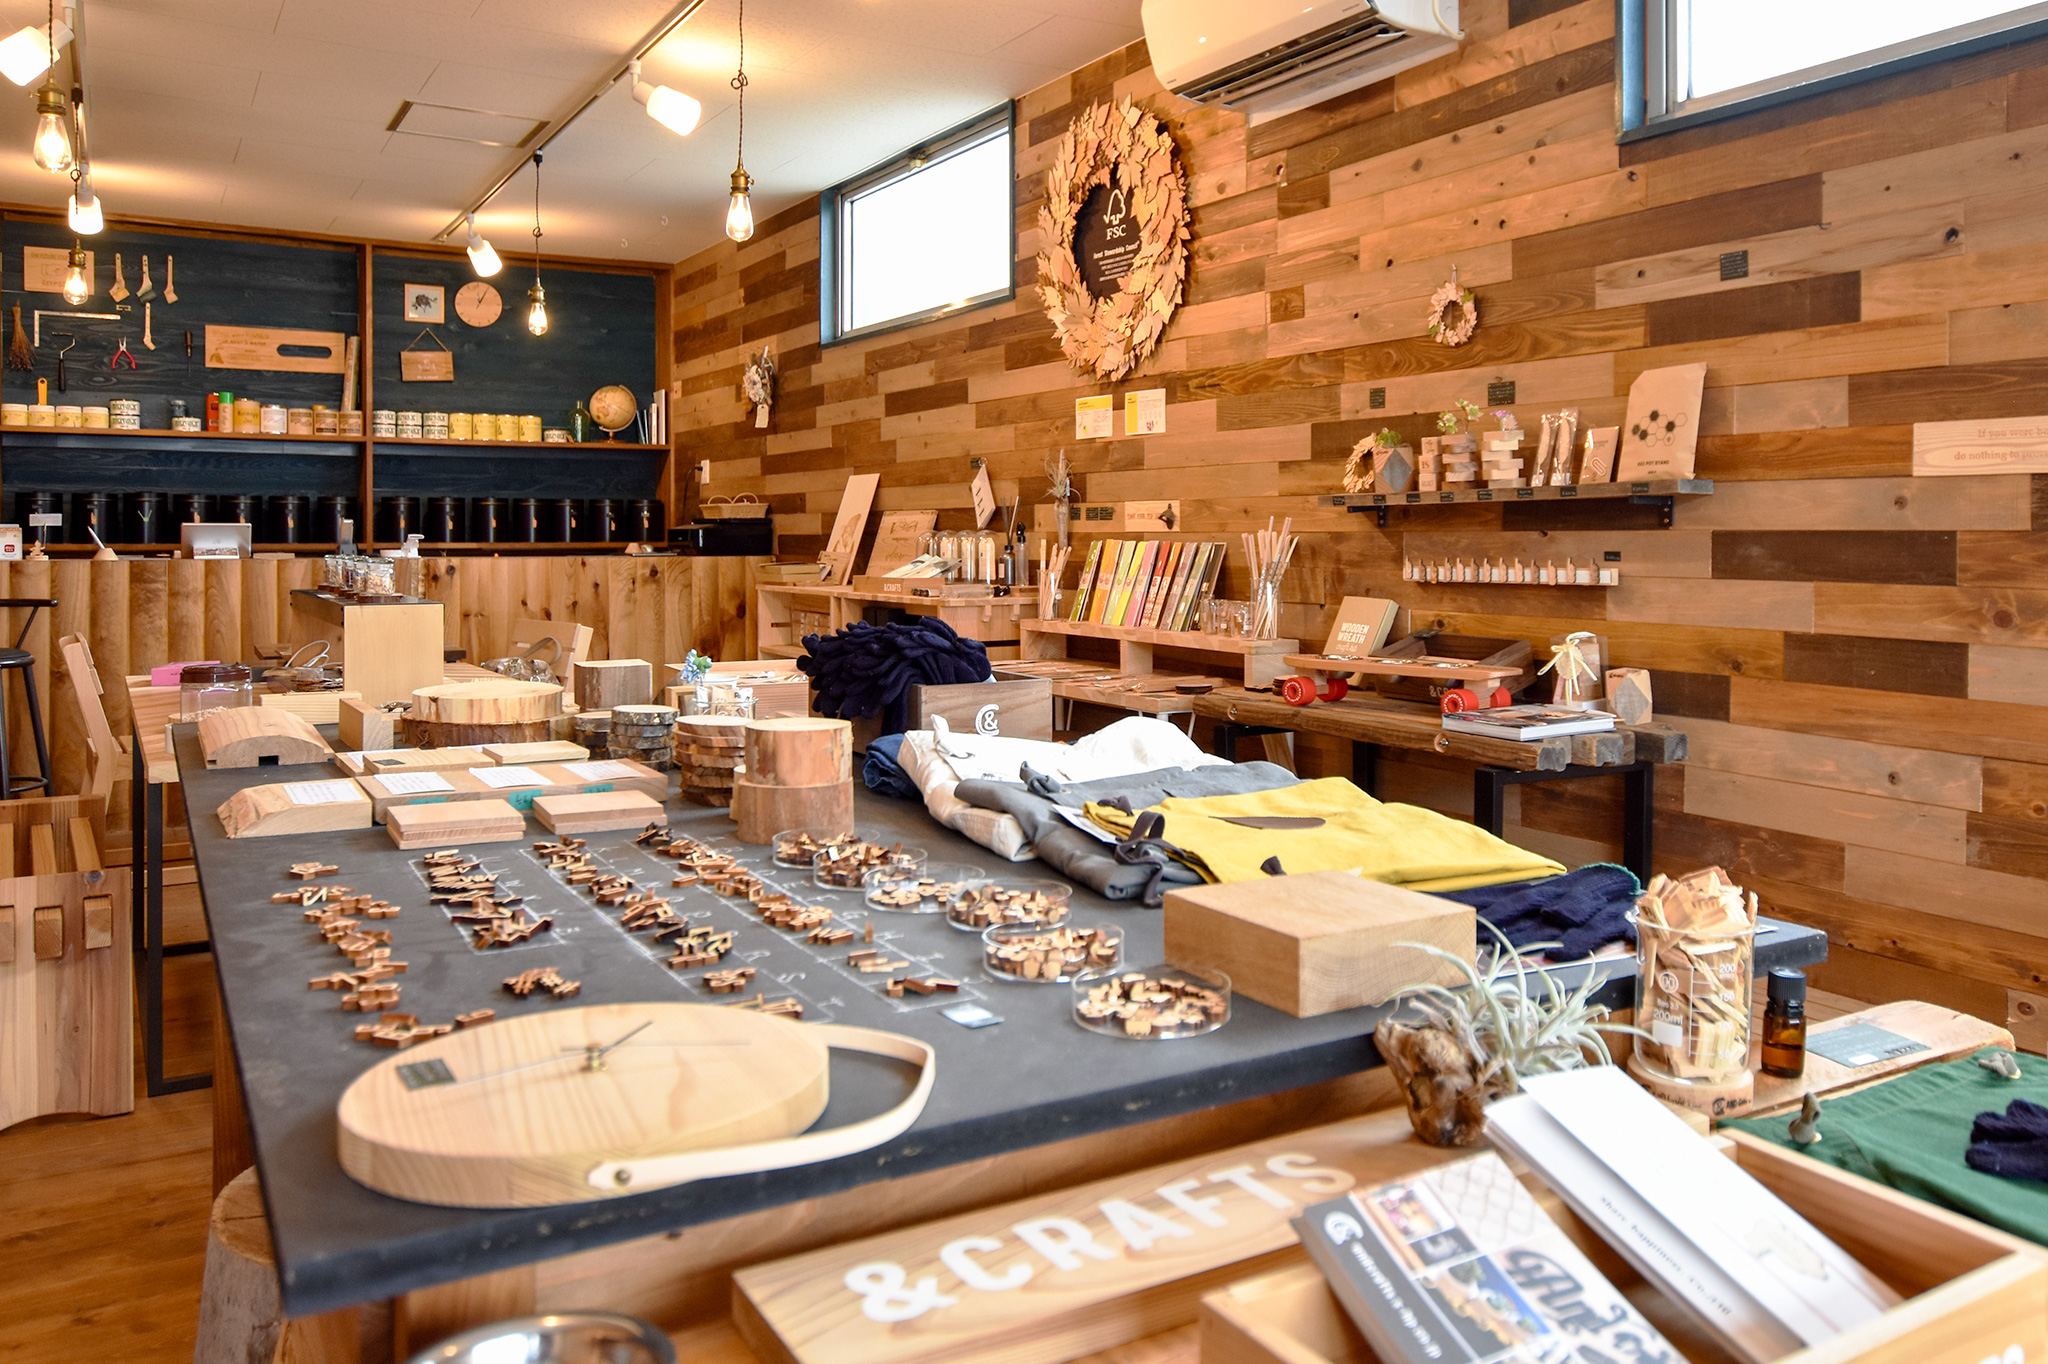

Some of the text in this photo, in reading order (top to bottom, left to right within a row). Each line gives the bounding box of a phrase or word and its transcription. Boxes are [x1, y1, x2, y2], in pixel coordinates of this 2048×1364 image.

[1106, 224, 1127, 241] FSC
[1988, 430, 2007, 438] you
[2009, 428, 2034, 437] were
[1954, 451, 1967, 461] do
[1968, 450, 2008, 462] nothing
[2009, 450, 2019, 459] to
[1340, 622, 1370, 635] WOODEN
[1337, 632, 1367, 645] WREATH
[1719, 963, 1736, 973] 200
[1719, 992, 1735, 1002] 150
[1653, 1008, 1683, 1025] 200ml
[1718, 1049, 1731, 1059] 50
[843, 1150, 1355, 1323] &CRAFTS
